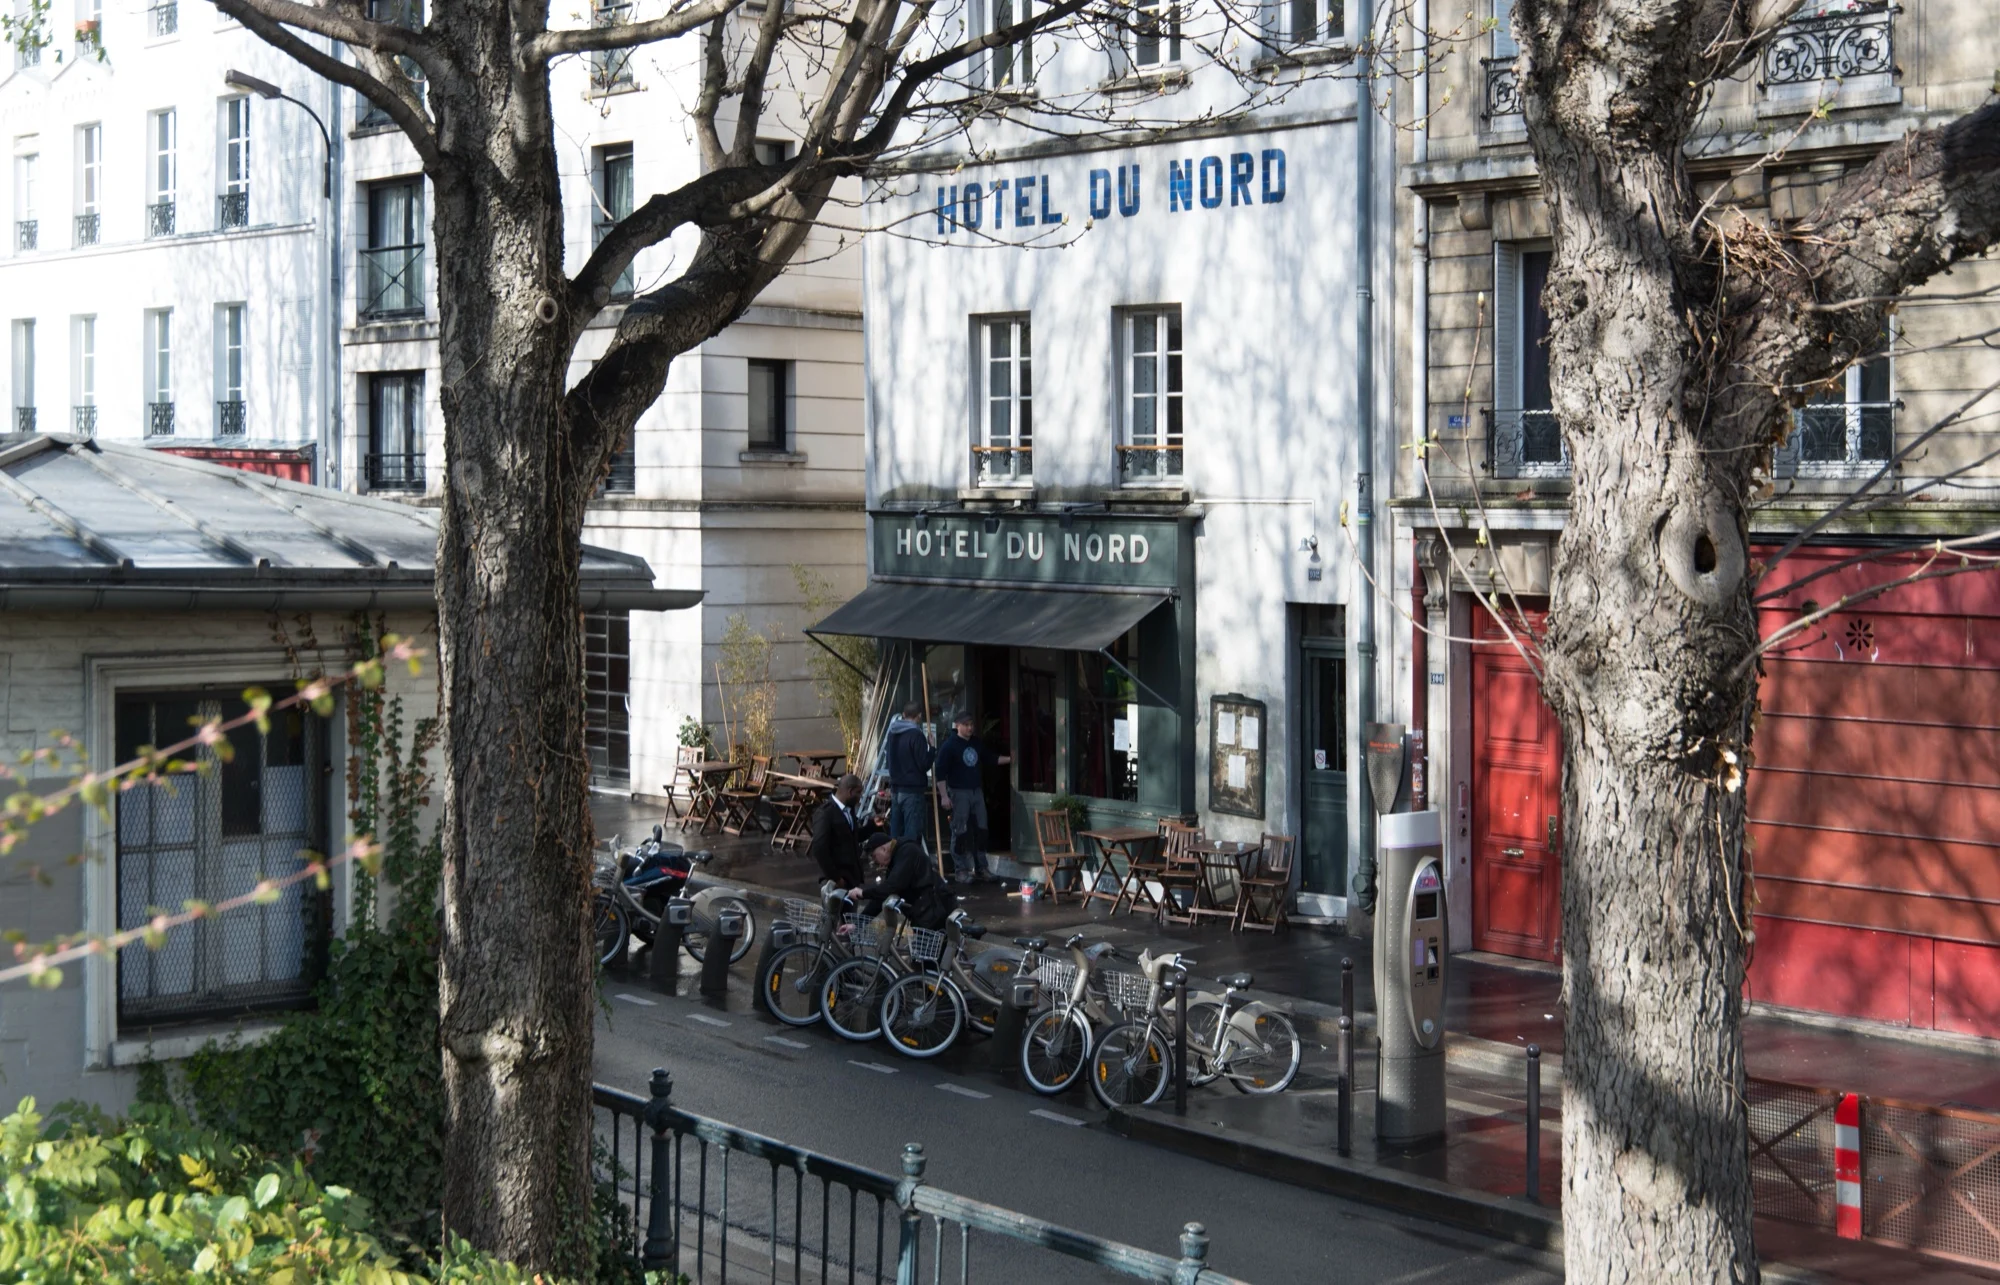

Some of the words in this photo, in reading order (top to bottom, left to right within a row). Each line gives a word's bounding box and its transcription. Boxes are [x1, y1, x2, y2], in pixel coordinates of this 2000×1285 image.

[937, 174, 1063, 235] HOTEL
[1089, 164, 1141, 220] DU
[1169, 148, 1286, 213] NORD
[896, 528, 988, 559] HOTEL
[1006, 531, 1044, 561] DU
[1064, 532, 1150, 564] NORD
